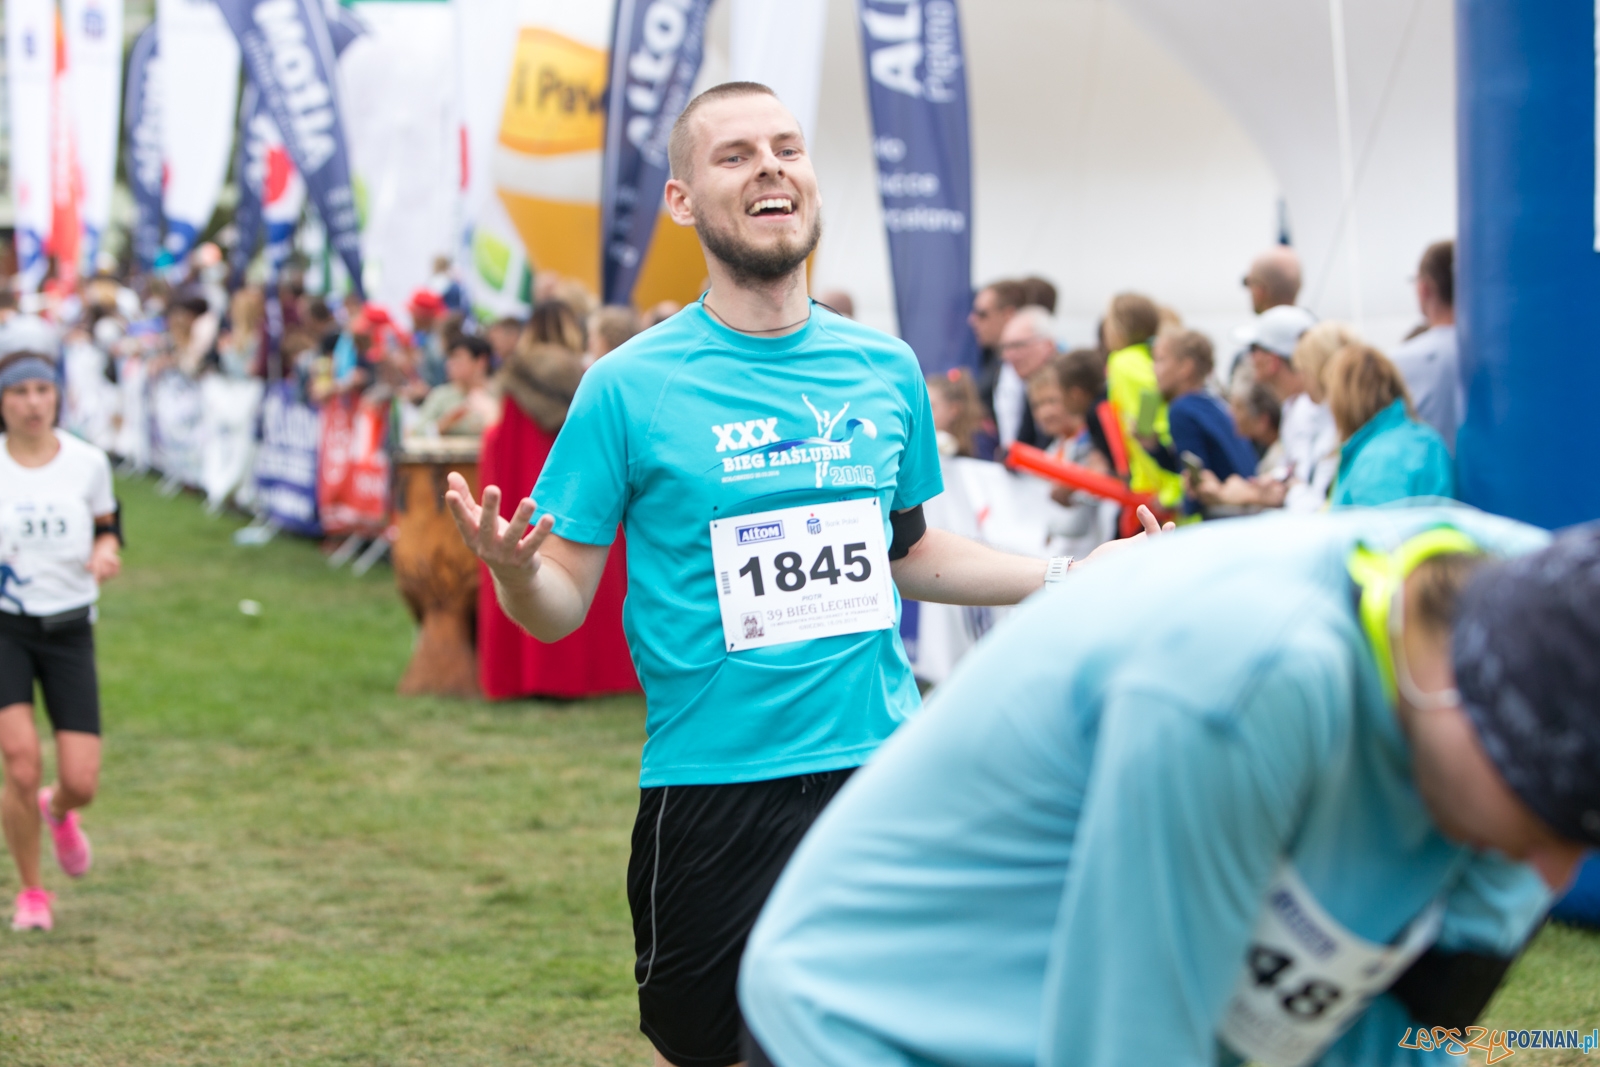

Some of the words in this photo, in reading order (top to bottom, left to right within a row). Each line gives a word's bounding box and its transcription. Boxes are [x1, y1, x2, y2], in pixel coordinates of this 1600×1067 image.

[711, 417, 781, 453] XXX
[722, 452, 766, 473] BIEG
[768, 445, 851, 467] ZAŚLUBIN
[829, 465, 876, 486] 2016
[738, 541, 872, 597] 1845
[766, 608, 783, 621] 39
[786, 603, 817, 618] BIEG
[820, 592, 879, 613] LECHITÓW
[801, 593, 823, 601] PIOTR
